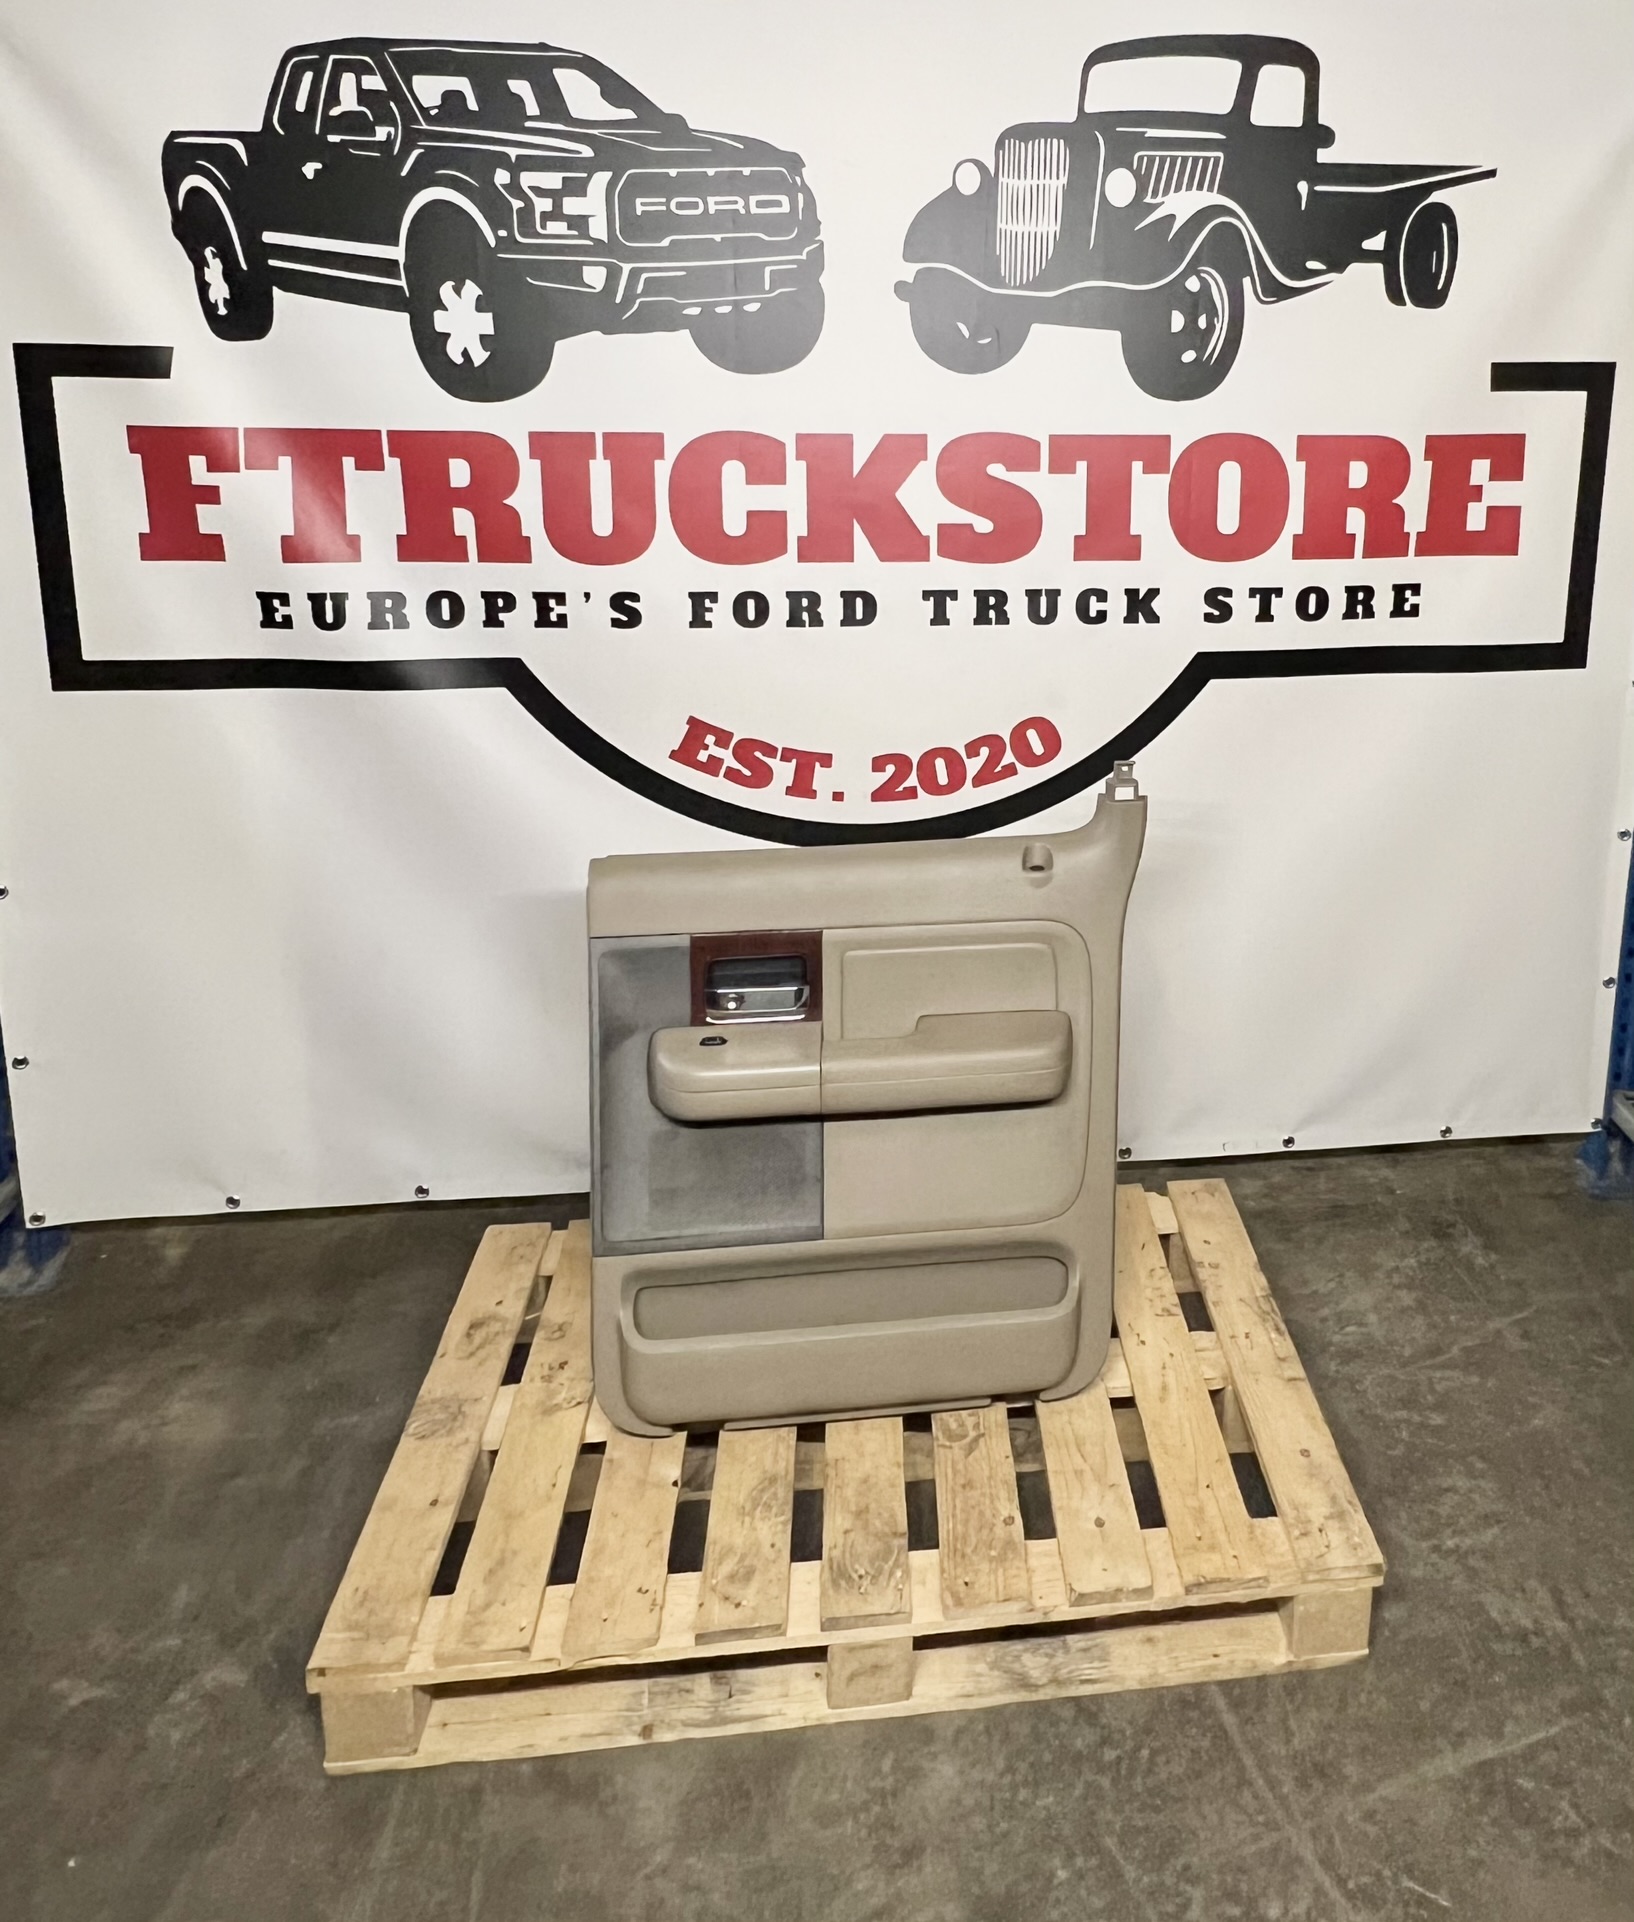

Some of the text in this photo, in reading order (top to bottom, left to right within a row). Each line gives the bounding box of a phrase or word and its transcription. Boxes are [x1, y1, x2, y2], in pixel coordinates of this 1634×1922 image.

[636, 195, 790, 215] FORD
[128, 426, 1526, 565] FTRUCKSTORE
[256, 583, 1421, 631] EUROPE'S FORD TRUCK STORE
[671, 717, 1061, 802] EST. 2020
